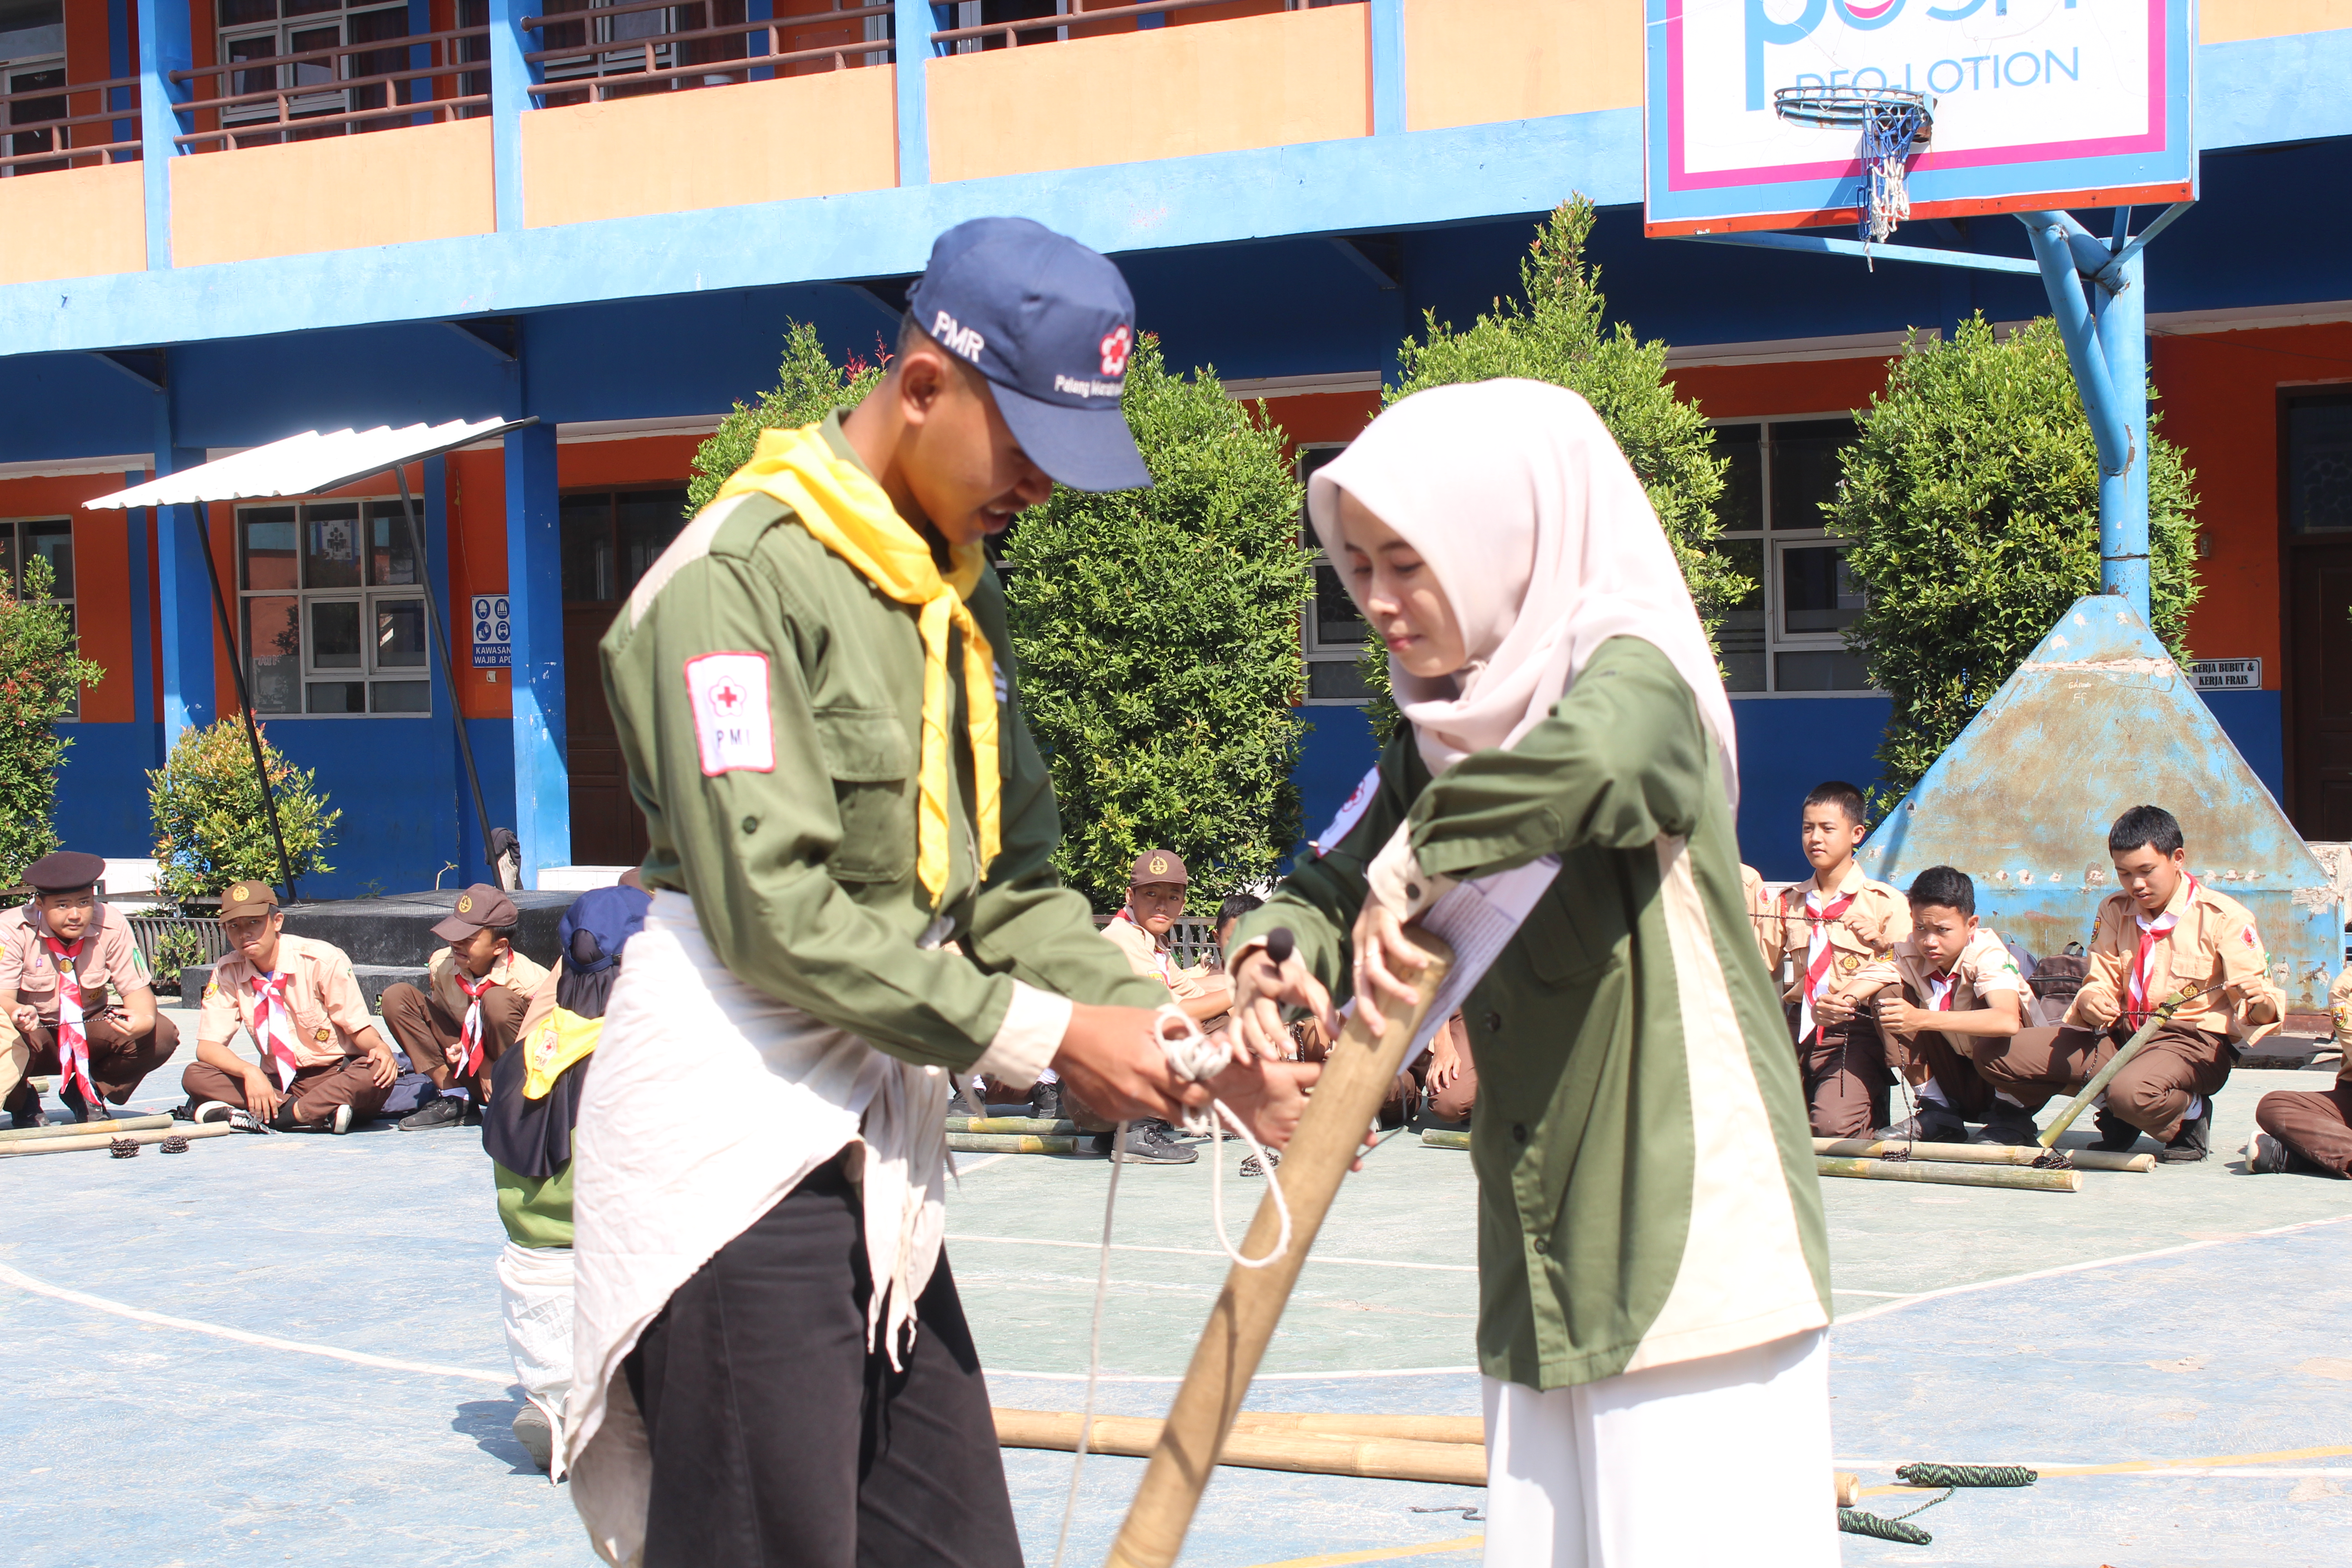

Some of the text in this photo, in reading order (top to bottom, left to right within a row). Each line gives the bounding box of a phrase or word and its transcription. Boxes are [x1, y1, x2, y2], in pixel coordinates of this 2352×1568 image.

[931, 310, 985, 363] PMR
[2192, 662, 2254, 674] KERJA BUBUT &
[2199, 675, 2248, 686] KERJA FRAIS
